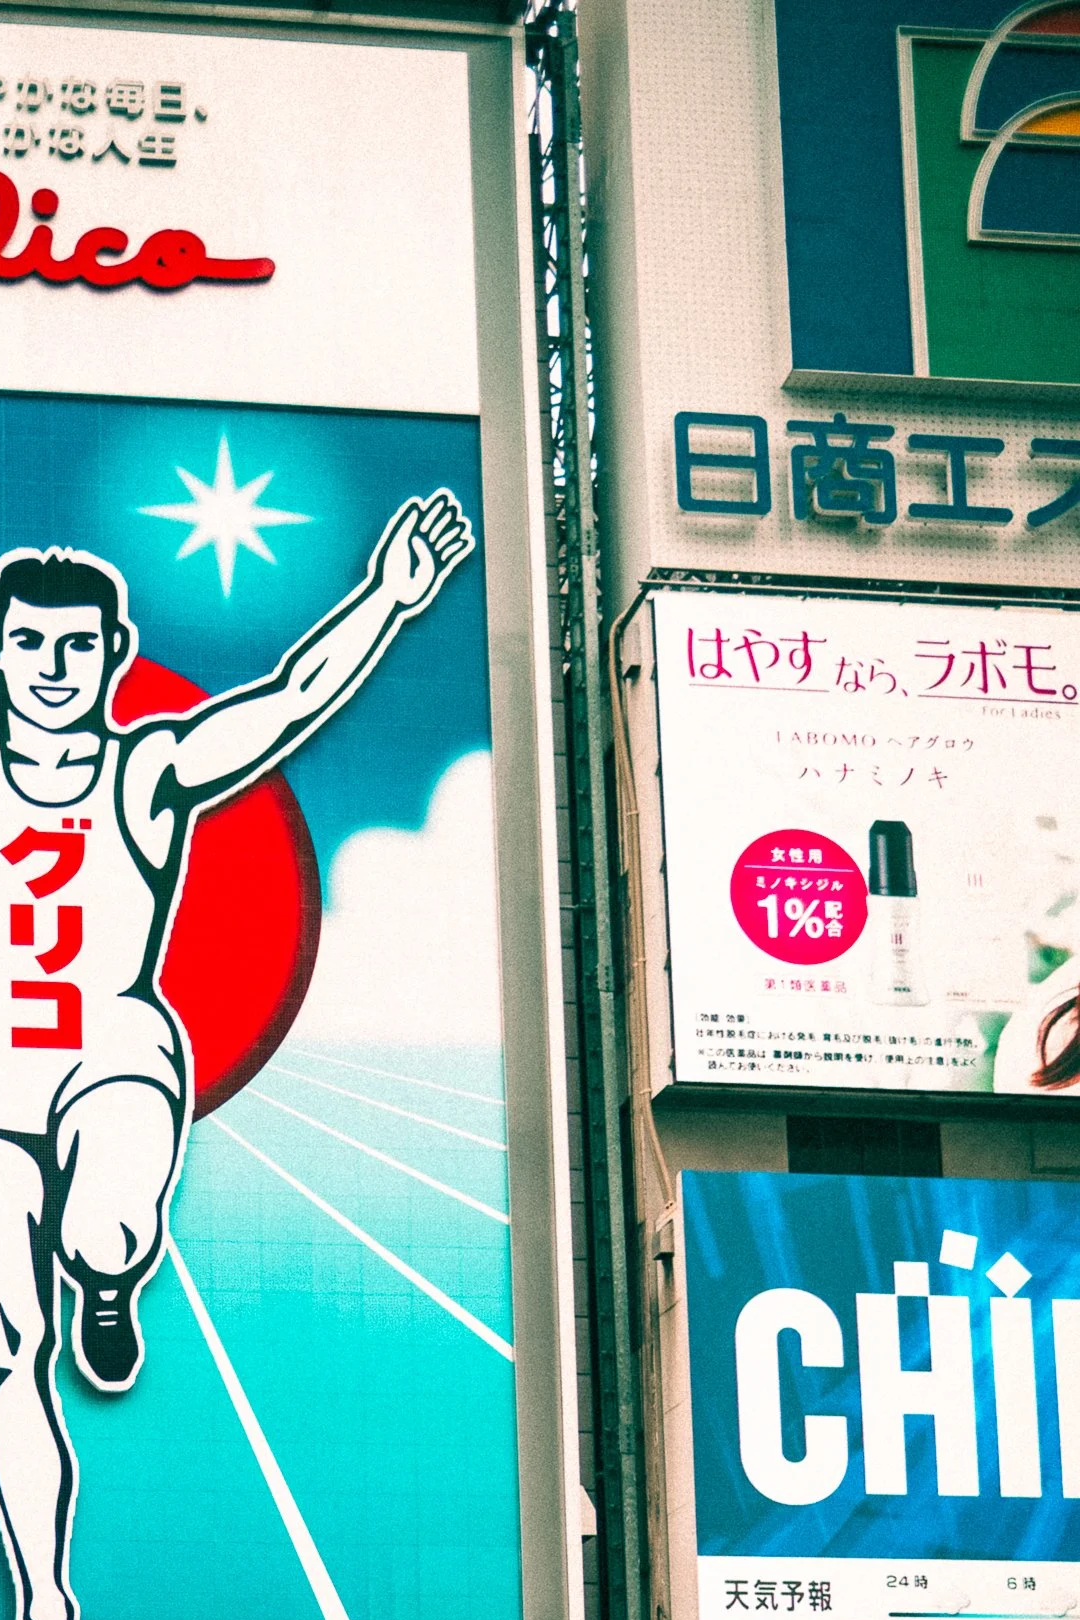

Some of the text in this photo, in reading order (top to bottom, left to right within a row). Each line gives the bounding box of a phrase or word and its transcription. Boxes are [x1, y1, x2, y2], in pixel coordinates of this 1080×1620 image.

[770, 847, 823, 864] 女性用
[756, 876, 844, 892] ミノキシジル
[757, 894, 824, 939] 1%
[0, 817, 92, 1050] グリコ
[886, 1574, 929, 1590] 24時
[724, 1579, 833, 1612] 天気予報
